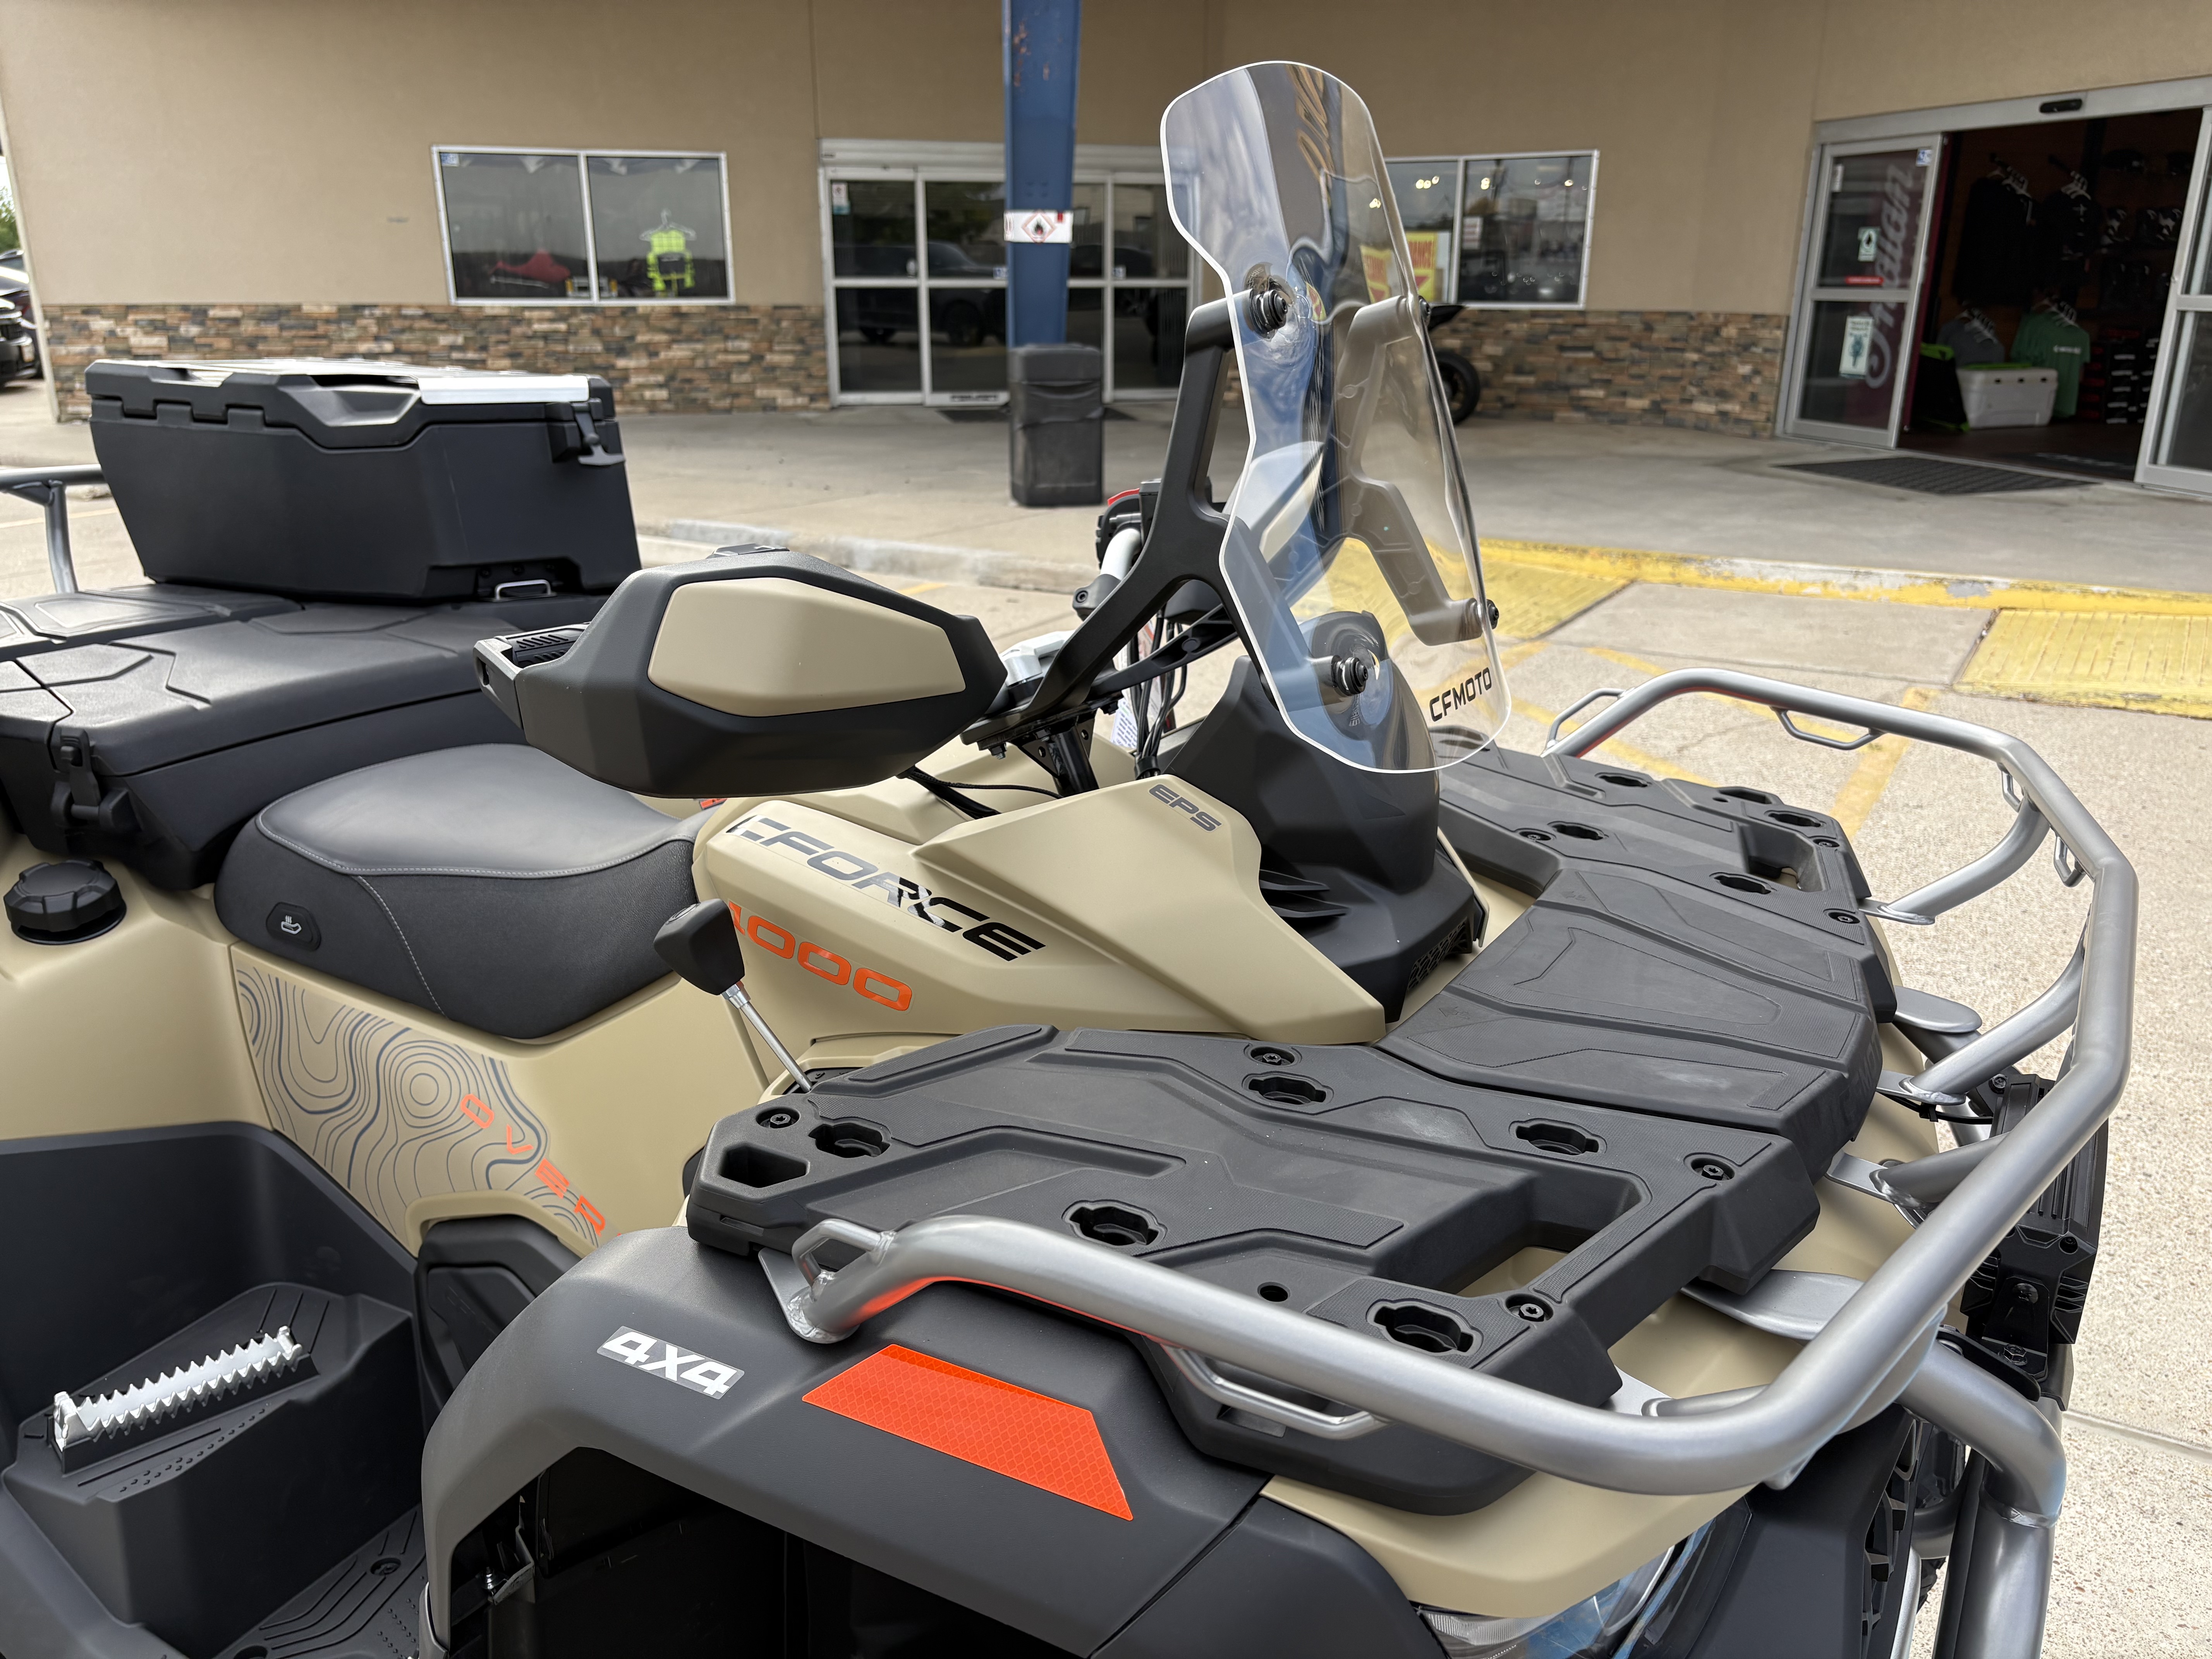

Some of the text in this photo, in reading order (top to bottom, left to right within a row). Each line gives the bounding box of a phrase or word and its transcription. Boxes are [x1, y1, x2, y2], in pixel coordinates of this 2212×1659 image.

[1429, 667, 1492, 722] CFMOTO
[1149, 784, 1222, 831] EPS
[725, 814, 1046, 962] CFORCE
[460, 1094, 622, 1237] OVER
[602, 1331, 737, 1396] 4X4
